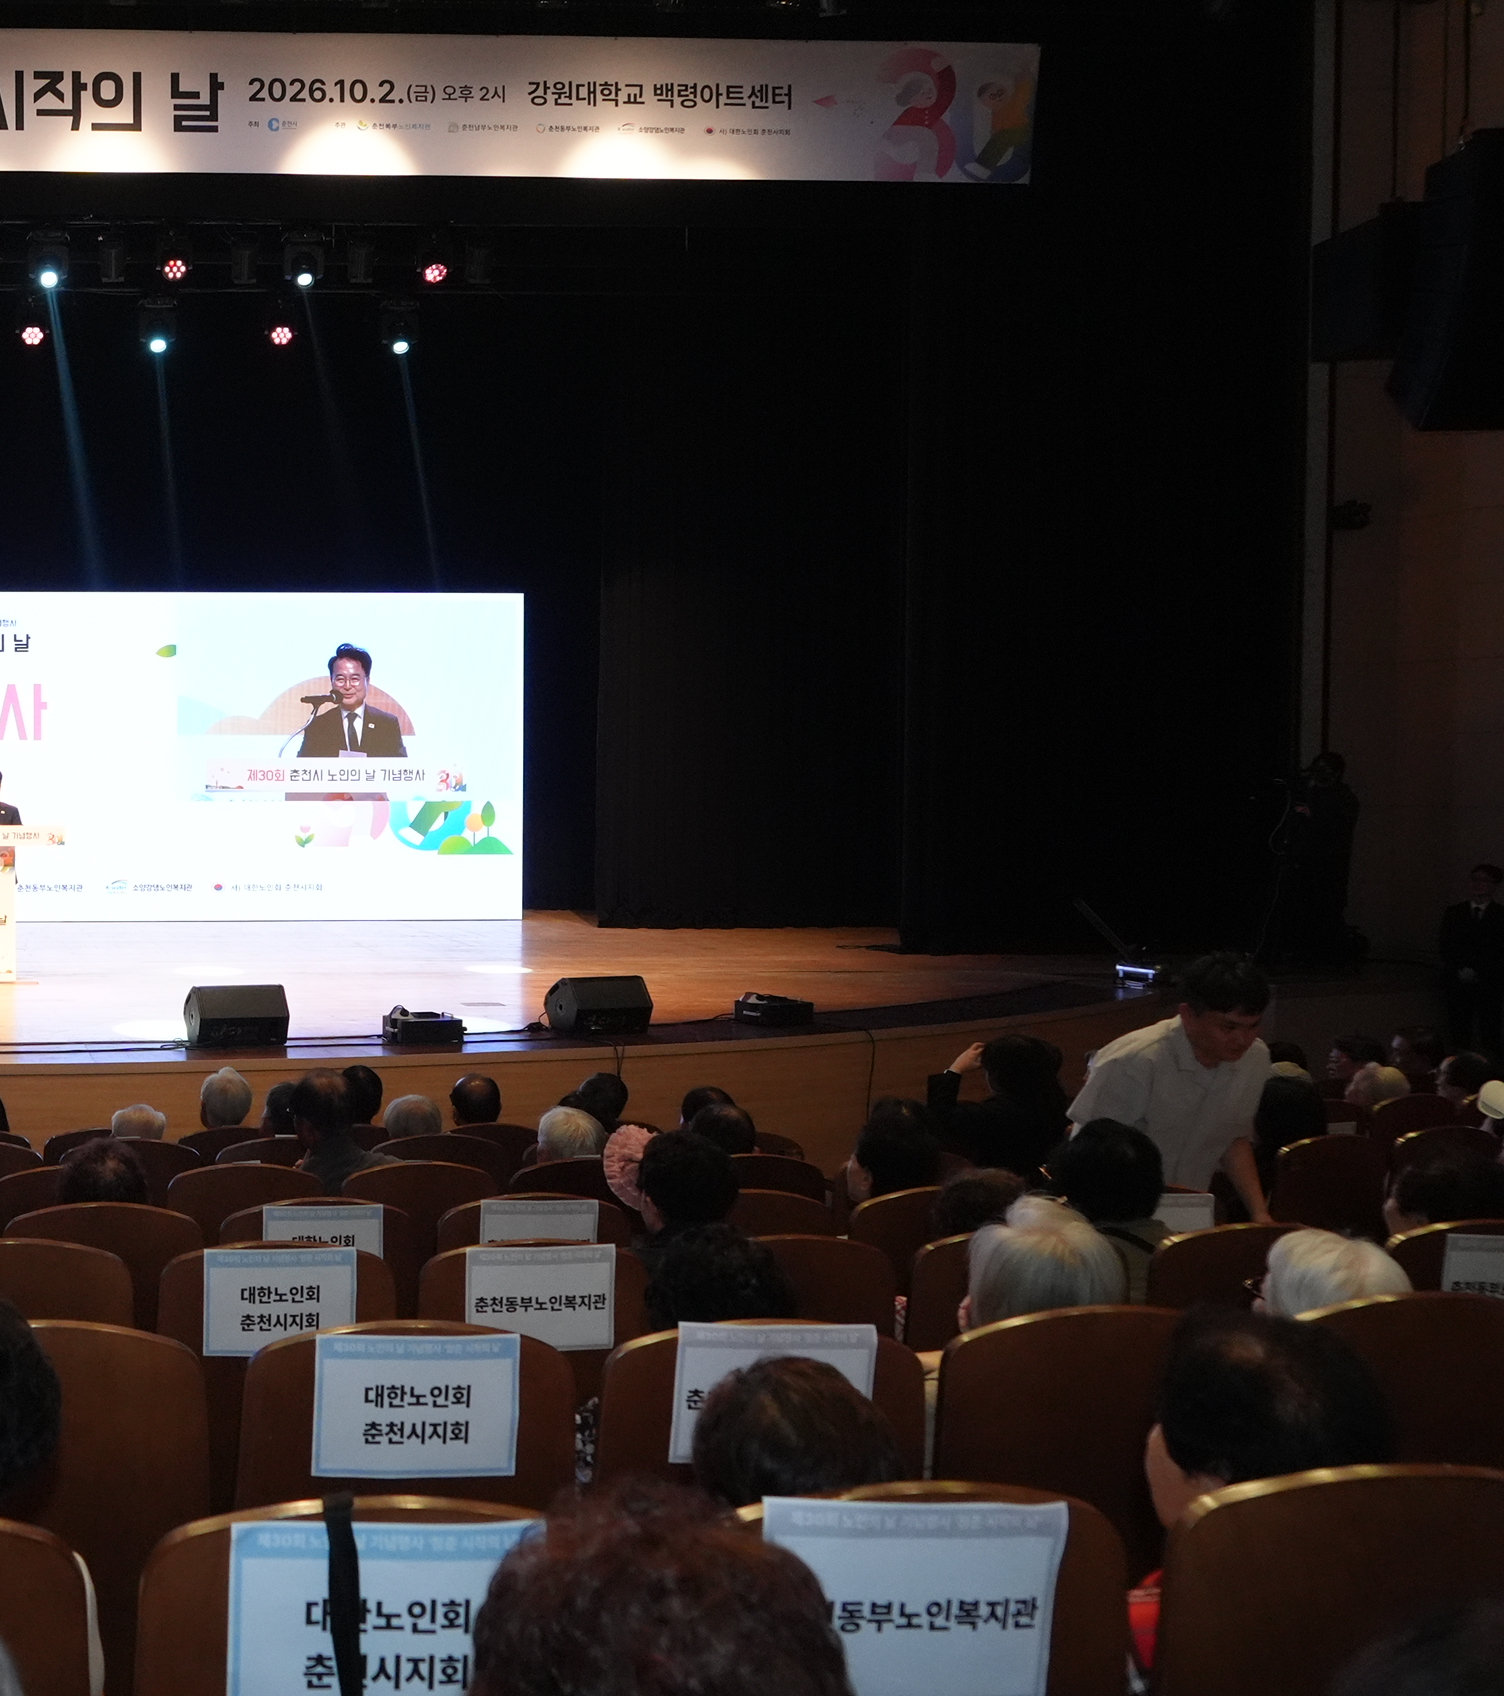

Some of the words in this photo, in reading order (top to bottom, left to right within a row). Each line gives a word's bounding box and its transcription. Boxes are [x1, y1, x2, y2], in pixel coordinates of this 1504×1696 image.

[170, 71, 226, 133] 날
[441, 84, 475, 102] 오후
[479, 85, 506, 103] 2시
[527, 80, 646, 108] 강원대학교
[653, 82, 793, 110] 백령아트센터
[248, 120, 260, 128] 주최
[462, 123, 519, 132] 춘천남부노인복지관
[548, 125, 600, 133] 춘천동부노인복지관
[13, 633, 31, 653] 날
[247, 769, 285, 782] 제30회
[289, 769, 323, 782] 춘천시
[327, 769, 361, 782] 노인의
[365, 769, 376, 782] 날
[380, 769, 426, 782] 기념행사
[240, 1285, 320, 1305] 대한노인회
[474, 1293, 607, 1313] 춘천동부노인복지관
[240, 1312, 320, 1332] 춘천시지회
[364, 1384, 471, 1408] 대한노인회
[363, 1421, 469, 1445] 춘천시지회
[827, 1597, 1039, 1634] 동부노인복지관
[303, 1653, 470, 1691] 춘시지회
